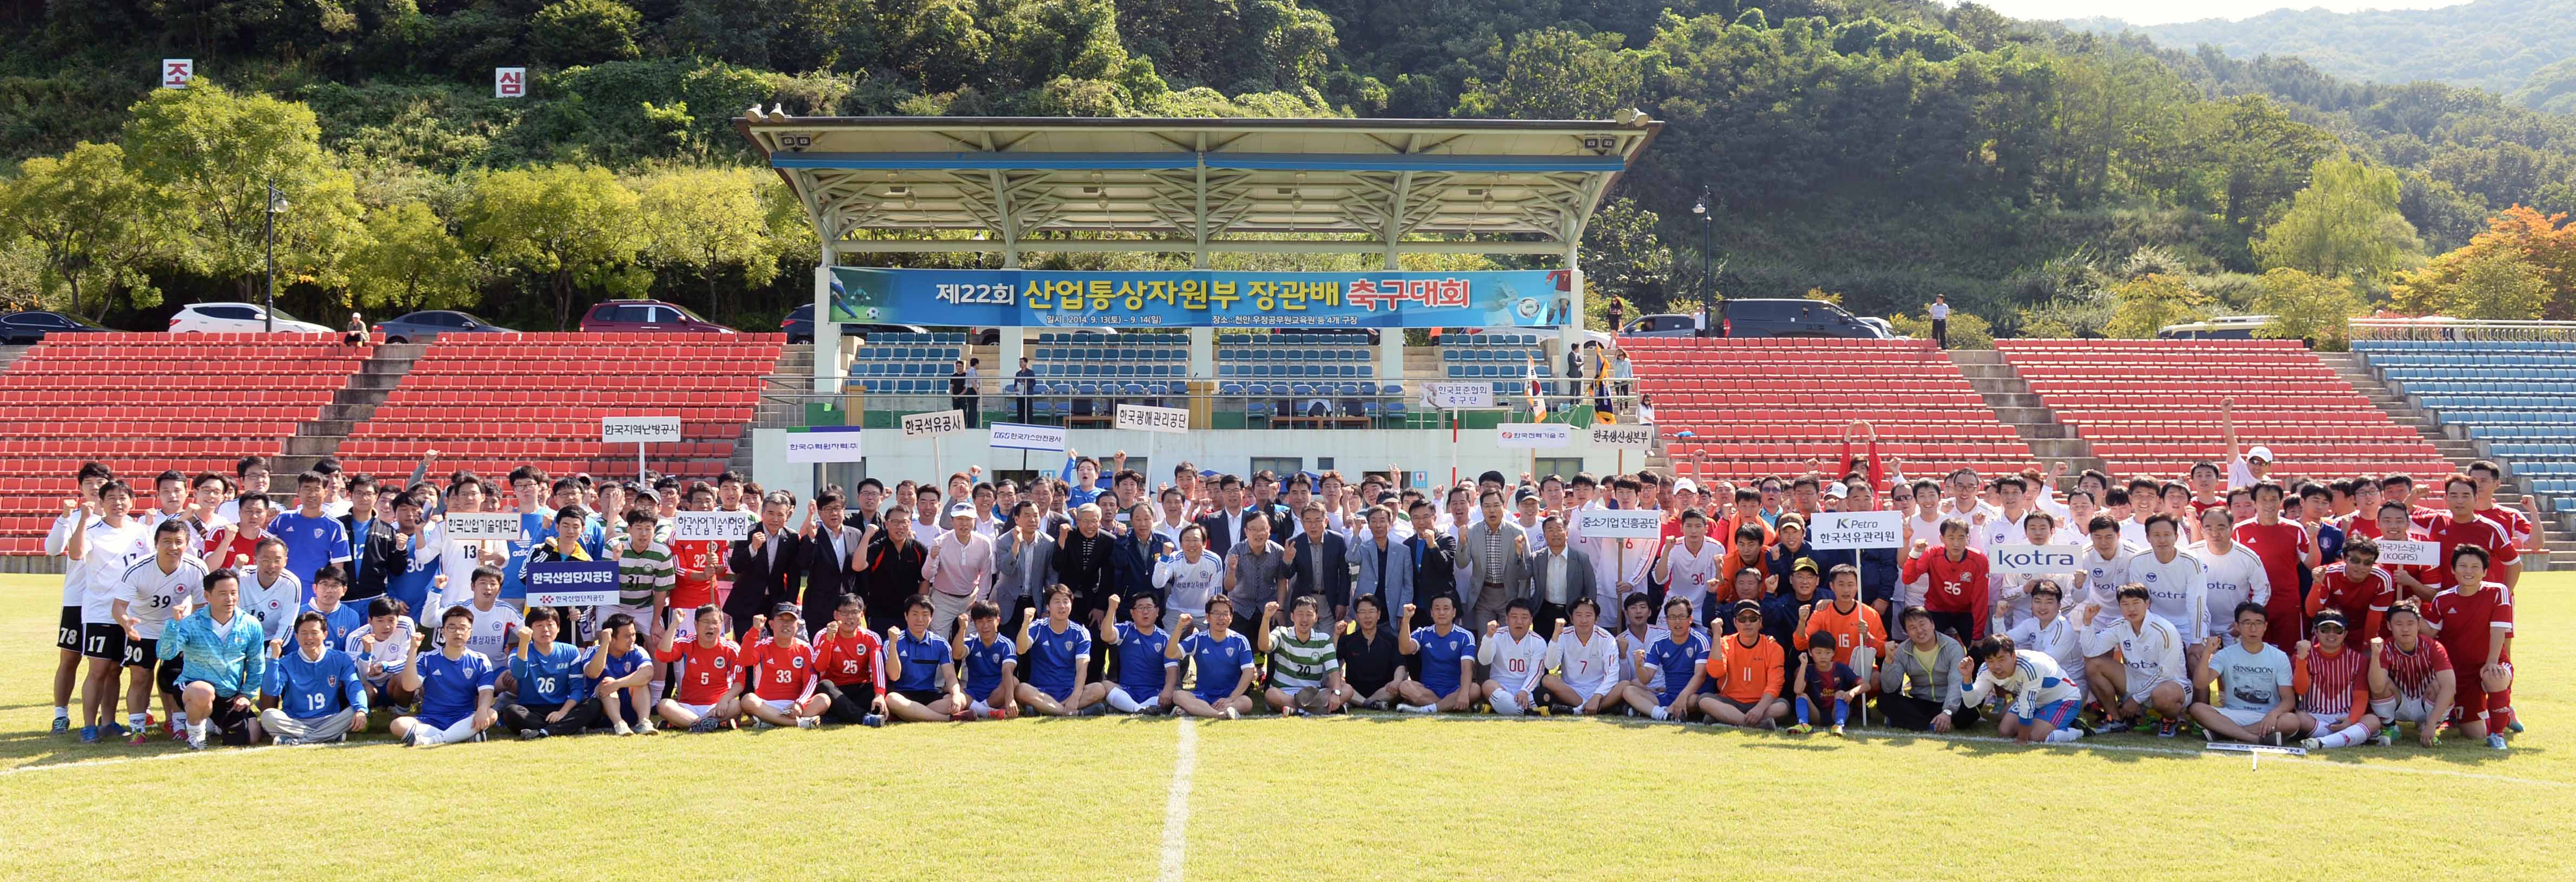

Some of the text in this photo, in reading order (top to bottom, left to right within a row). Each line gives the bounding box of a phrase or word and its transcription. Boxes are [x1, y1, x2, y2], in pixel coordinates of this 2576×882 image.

[167, 63, 188, 84] 조
[500, 71, 521, 95] 심
[935, 278, 1471, 312] 제22회 산업통상자원부 장관배 축구대회
[1046, 315, 1062, 324] 일시
[1100, 316, 1121, 324] 13(토)
[1140, 316, 1161, 324] 14(일)
[1212, 316, 1229, 324] 장소
[1234, 316, 1250, 324] 천안
[1252, 316, 1316, 324] 우정공무원교육원
[1317, 316, 1325, 324] 등
[1327, 316, 1340, 324] 4개
[1342, 316, 1358, 324] 구장
[1438, 386, 1487, 394] 한국표준협회
[1449, 396, 1456, 404] 축
[1469, 396, 1477, 404] 단
[905, 415, 961, 435] 한국석유공사
[1120, 410, 1186, 428] 한국광해관리공단
[605, 424, 679, 435] 한국지역난방공사
[1011, 432, 1061, 442] 한국가스안전공사
[1594, 430, 1648, 444] 한국생산성본부
[448, 518, 518, 534] 한국산업기술대학교
[678, 516, 747, 536] 한국산업기술시험원
[1582, 517, 1658, 529] 중소기업 진흥공단
[1836, 519, 1849, 529] K
[1820, 531, 1895, 544] 한국석유관리원
[463, 545, 477, 559] 13
[2383, 553, 2418, 561] (KOGAS)
[693, 554, 706, 568] 32
[1999, 550, 2074, 568] kotra
[532, 571, 613, 584] 한국산업단지공단
[627, 576, 640, 588] 31
[1691, 573, 1704, 585] 30
[1944, 581, 1961, 596] 26
[2207, 581, 2236, 590] otra
[150, 595, 171, 609] 39
[556, 594, 604, 603] 한국산업단지공단
[251, 610, 265, 622] 18
[59, 627, 77, 645] 78
[1838, 634, 1849, 647] 16
[89, 636, 106, 653] 17
[125, 645, 142, 663] 90
[843, 660, 858, 674] 25
[1298, 665, 1311, 676] 20
[1509, 659, 1524, 672] 00
[1580, 660, 1587, 674] 7
[701, 672, 709, 685] 5
[776, 670, 792, 683] 33
[1743, 667, 1751, 681] 11
[537, 678, 555, 693] 26
[307, 693, 326, 711] 19
